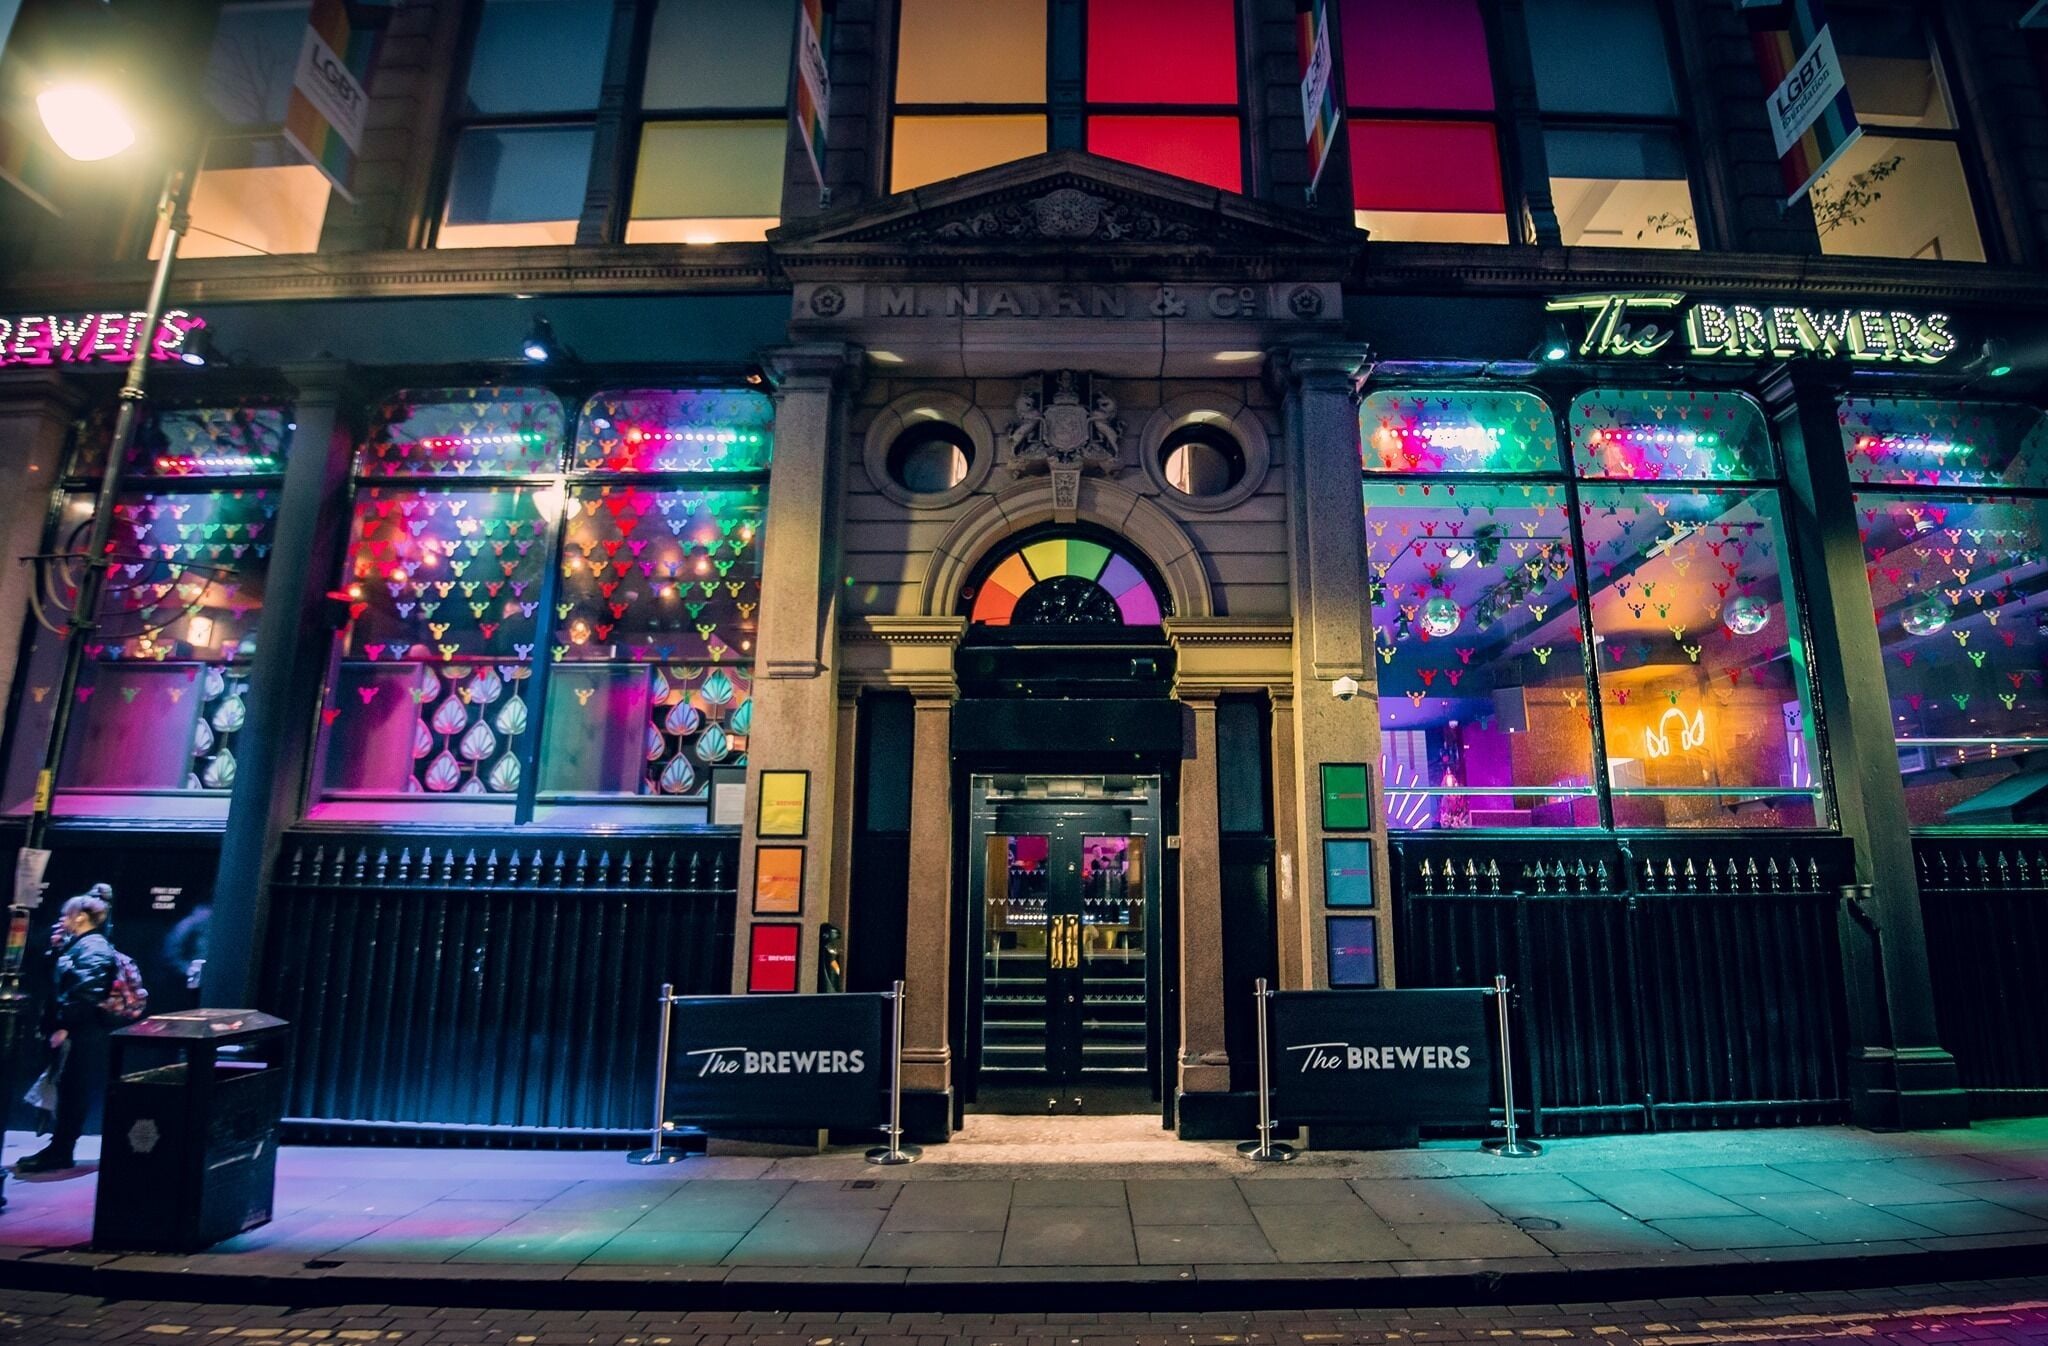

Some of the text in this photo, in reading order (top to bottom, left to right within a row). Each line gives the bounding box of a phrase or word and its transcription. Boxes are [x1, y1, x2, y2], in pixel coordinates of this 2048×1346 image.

[312, 43, 362, 111] LGBT
[1776, 44, 1822, 117] LGBT
[945, 286, 1126, 318] NAIRN
[1149, 286, 1186, 316] &
[1545, 292, 1956, 361] The BREWERS
[686, 1047, 865, 1077] The BREWERS
[1286, 1042, 1471, 1073] The BREWERS
